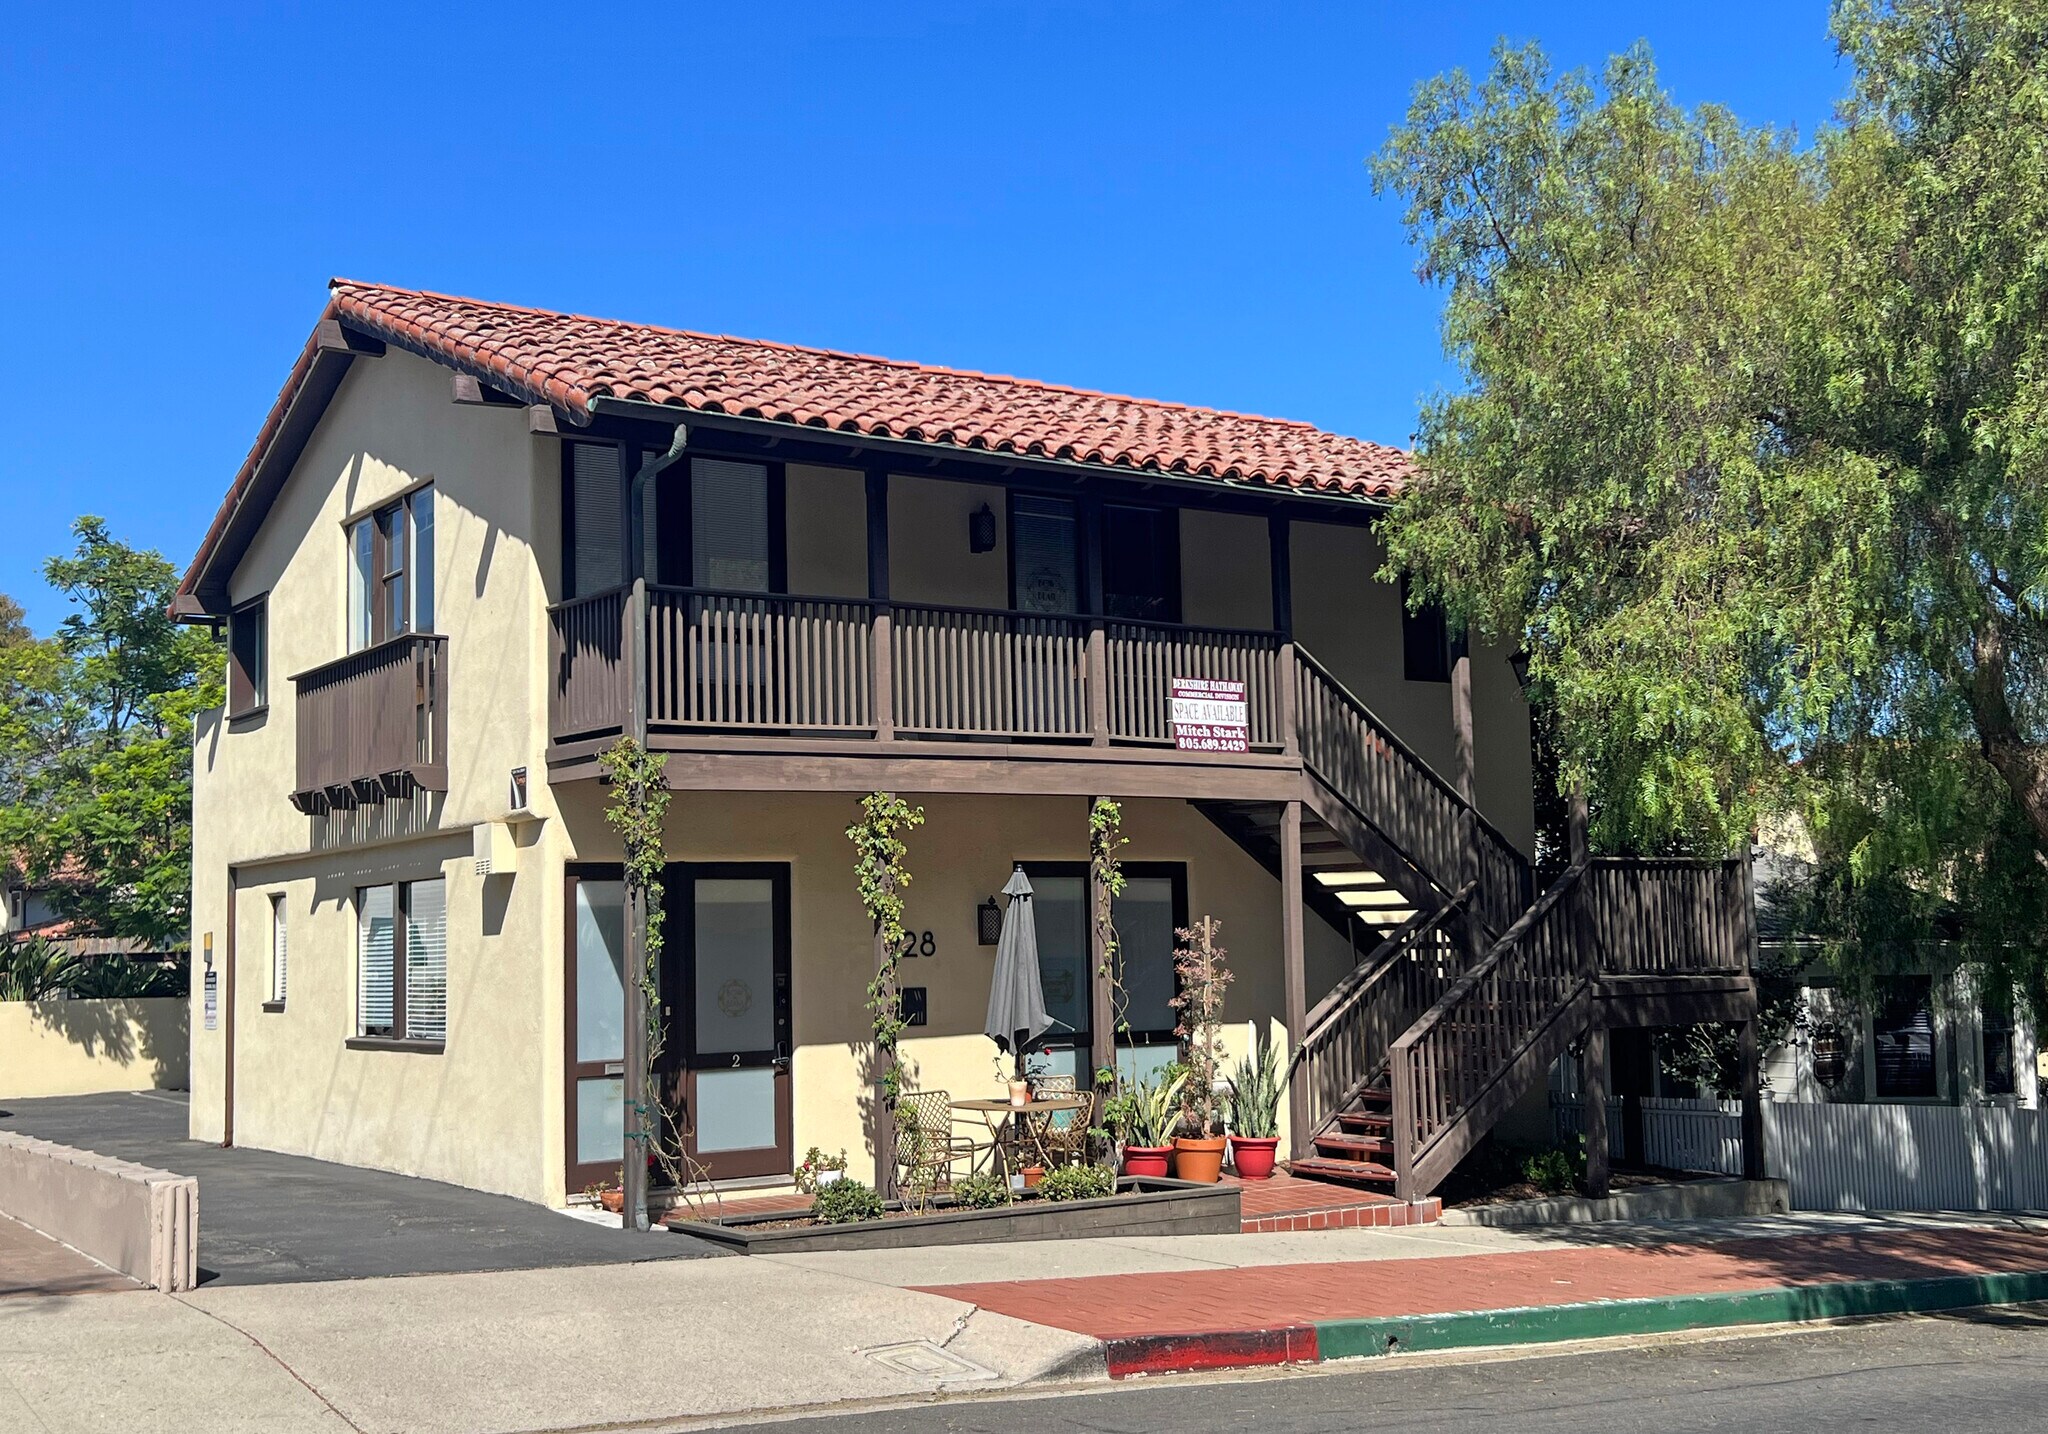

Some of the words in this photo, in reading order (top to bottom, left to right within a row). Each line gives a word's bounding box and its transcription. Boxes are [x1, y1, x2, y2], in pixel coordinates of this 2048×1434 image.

[1173, 678, 1209, 690] BERKSHIRE
[1174, 702, 1199, 720] SPACE
[1202, 704, 1244, 722] AVAILABLE
[1175, 725, 1211, 737] Mitch
[1213, 726, 1245, 738] Stark
[1178, 737, 1246, 751] 805.689.2429
[894, 931, 936, 957] 28
[731, 1054, 741, 1068] 2
